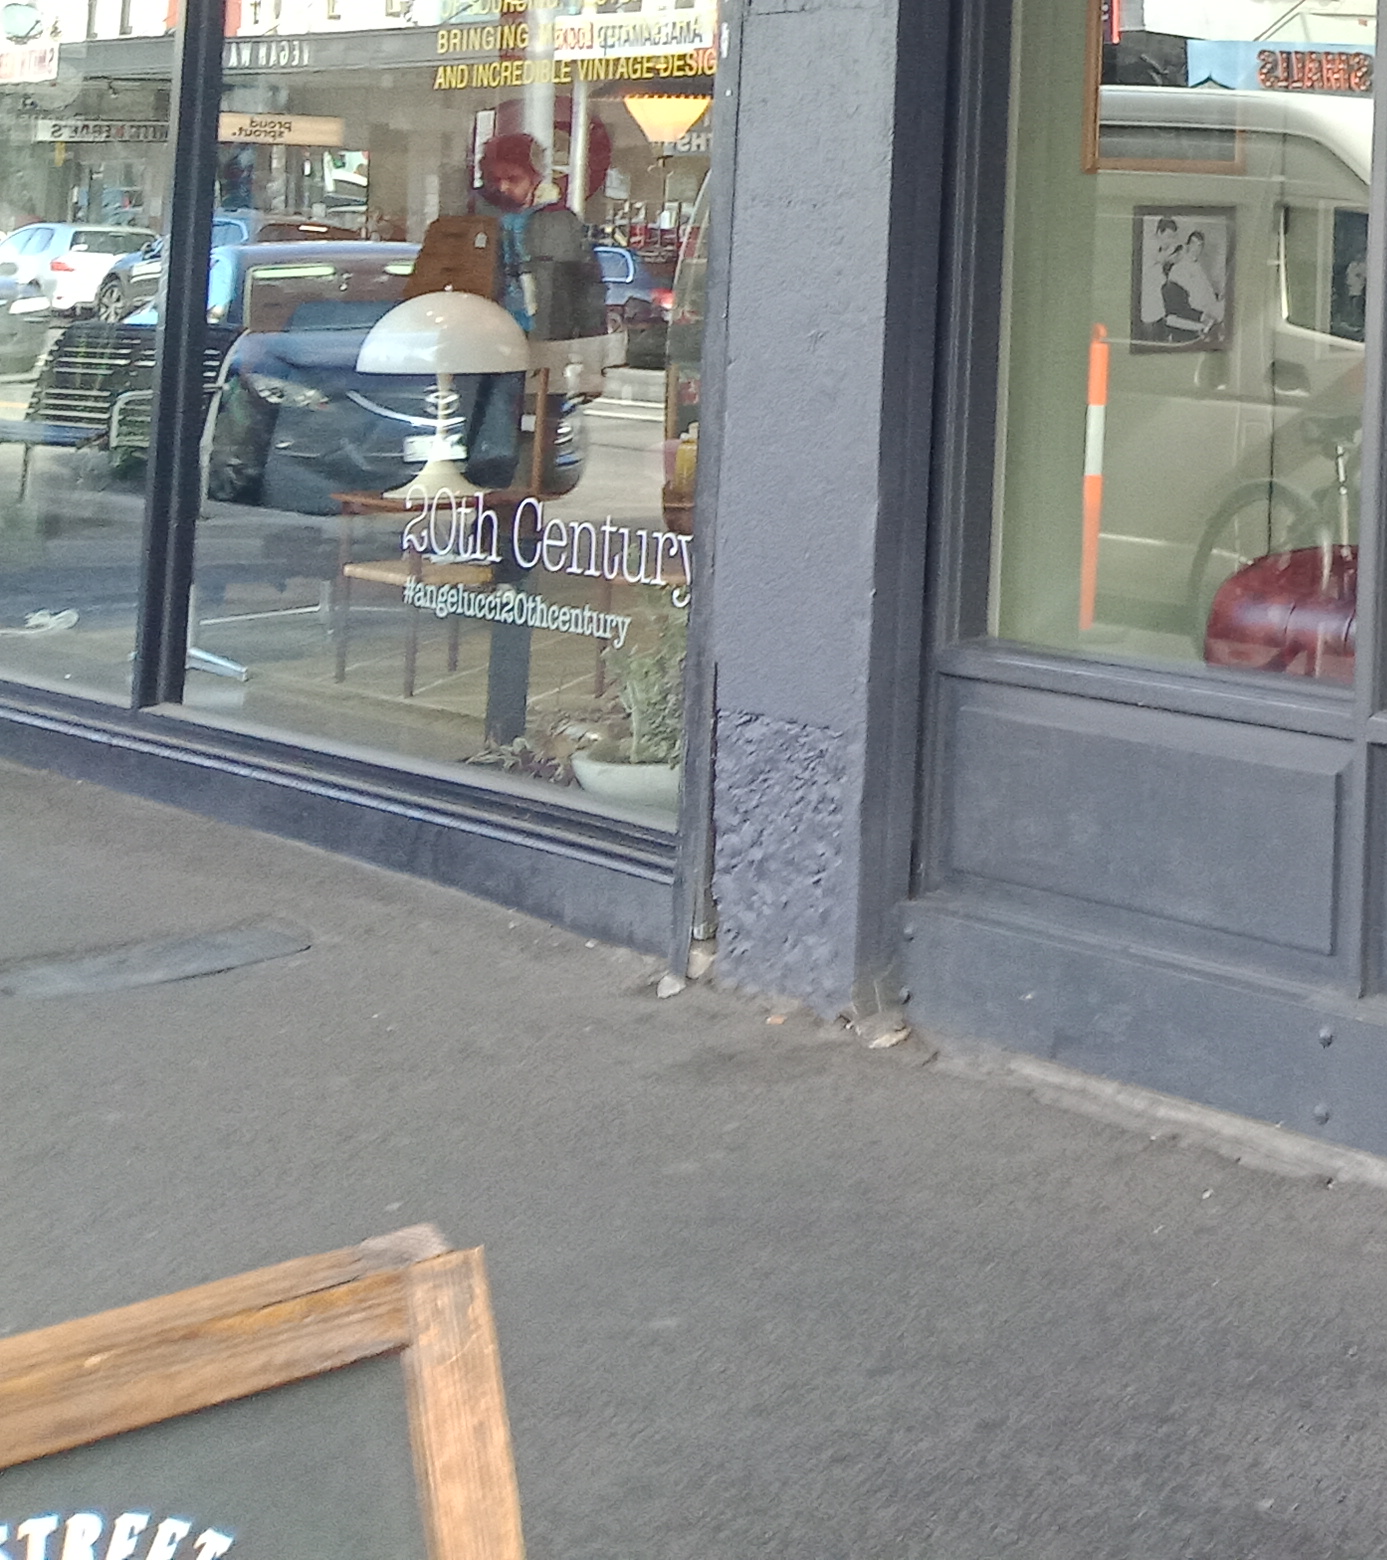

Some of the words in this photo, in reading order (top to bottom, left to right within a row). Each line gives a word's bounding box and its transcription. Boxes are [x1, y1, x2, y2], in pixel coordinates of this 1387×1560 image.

[437, 22, 530, 54] BRINGING
[434, 61, 467, 90] AND
[472, 59, 573, 88] INCREDIBLE
[578, 52, 654, 81] VINTAGE
[402, 485, 502, 564] 20th
[513, 497, 693, 608] Century
[403, 575, 632, 650] #angelucci20thcentury
[0, 1511, 235, 1560] TREET
